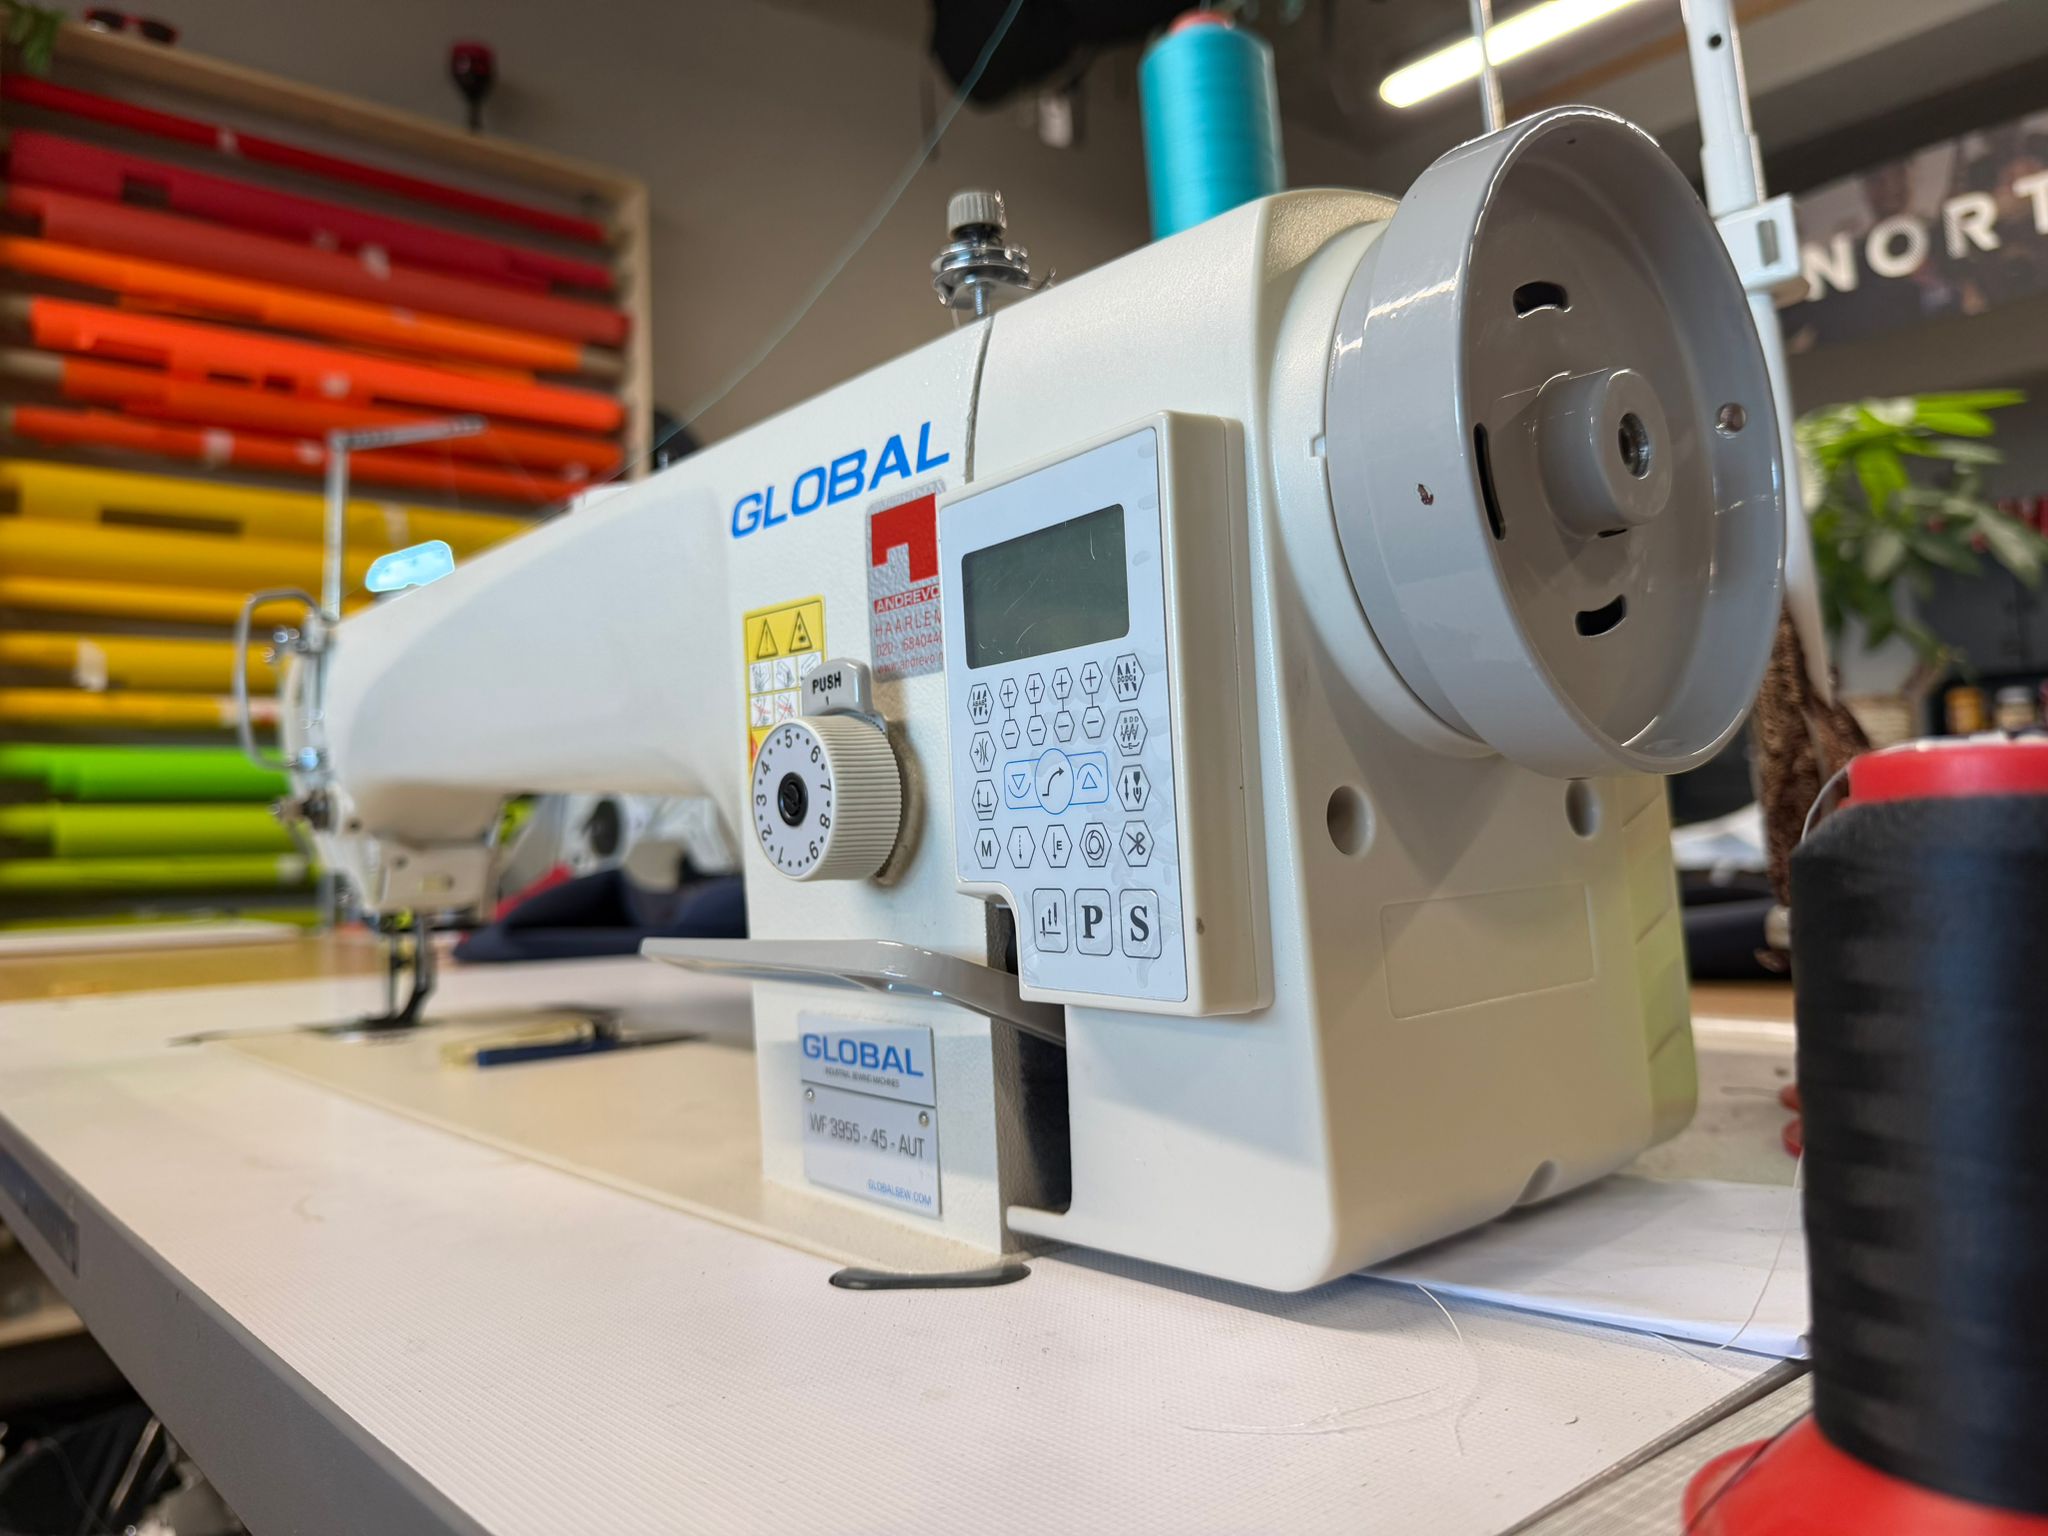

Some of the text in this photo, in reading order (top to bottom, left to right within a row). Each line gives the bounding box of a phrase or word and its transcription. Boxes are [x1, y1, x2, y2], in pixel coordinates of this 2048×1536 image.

[731, 421, 949, 539] GLOBAL
[812, 671, 842, 694] PUSH
[757, 729, 832, 865] 1 2 3 4 5 6 7 8 9
[981, 840, 992, 857] M
[1056, 840, 1063, 851] E
[1081, 904, 1150, 942] P S
[802, 1033, 924, 1078] GLOBAL
[809, 1111, 827, 1134] WF
[829, 1117, 861, 1144] 3955
[871, 1128, 888, 1150] 45
[899, 1134, 925, 1159] AUT
[867, 1178, 932, 1209] GLOBALSEW.COM
